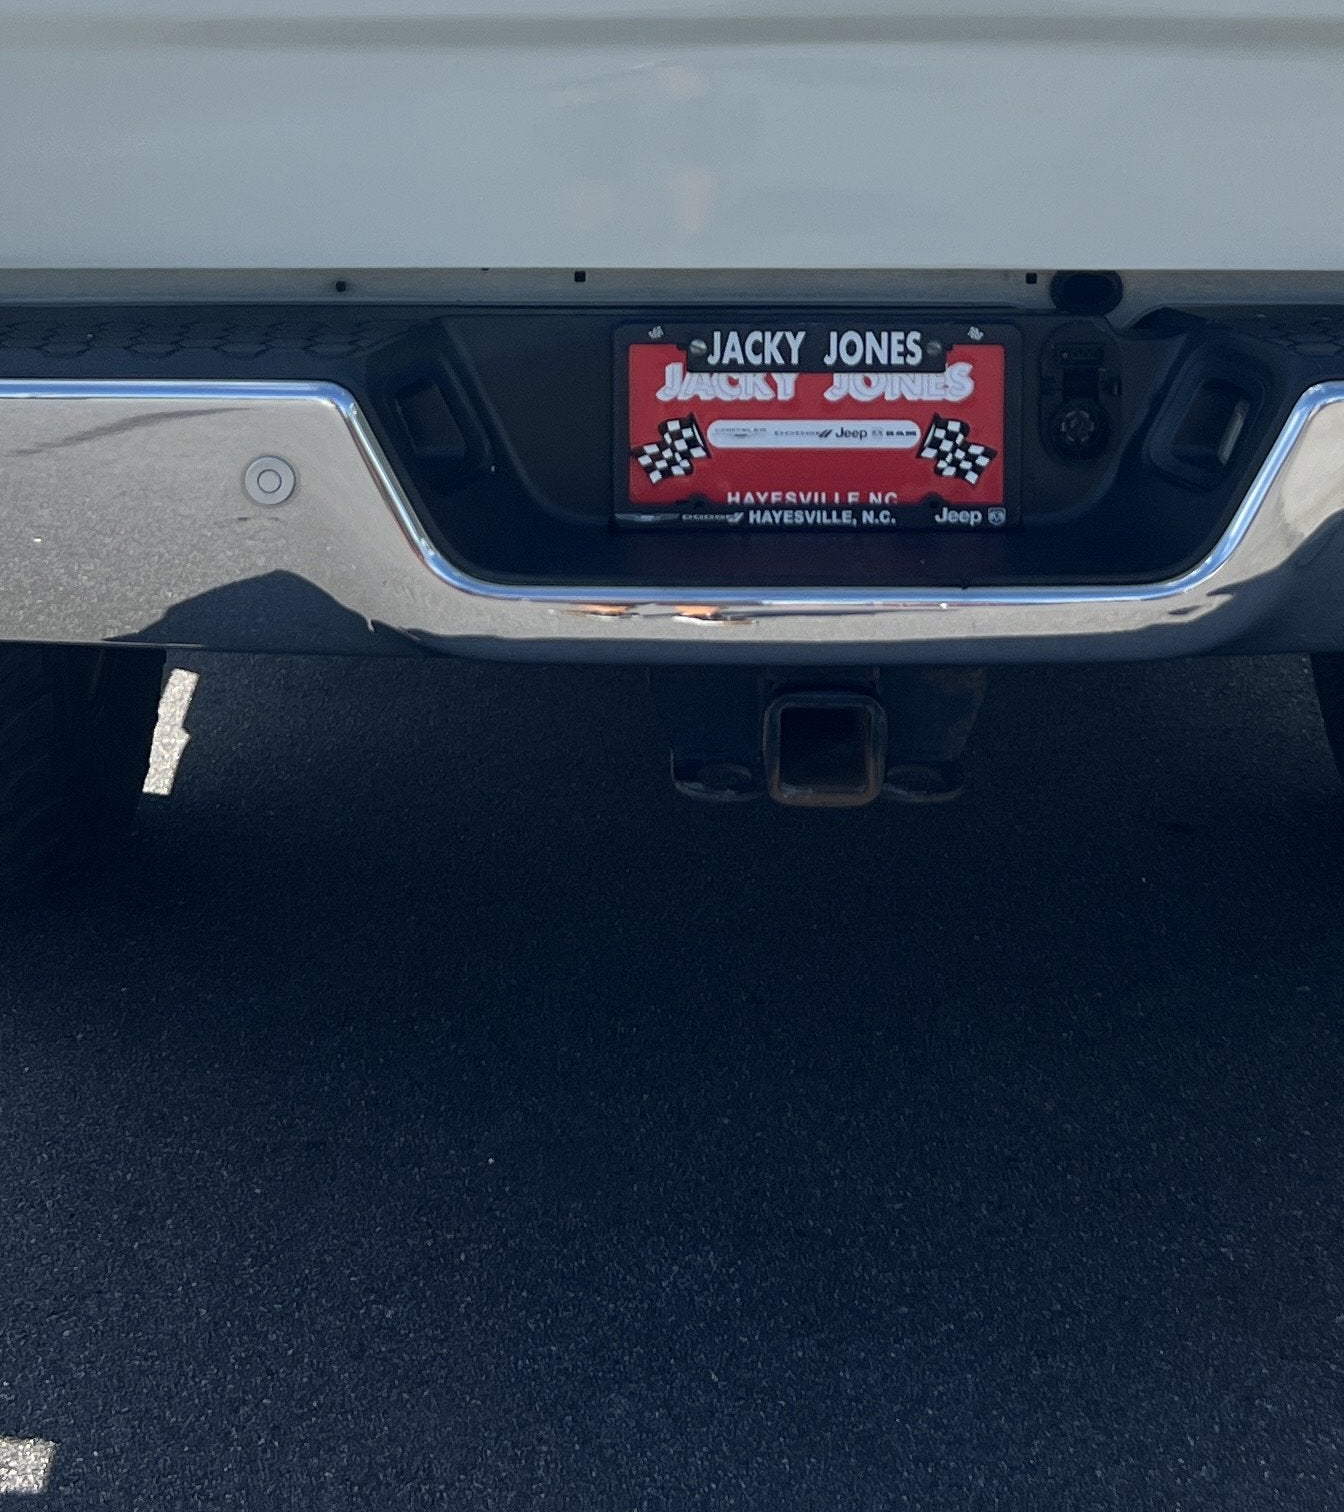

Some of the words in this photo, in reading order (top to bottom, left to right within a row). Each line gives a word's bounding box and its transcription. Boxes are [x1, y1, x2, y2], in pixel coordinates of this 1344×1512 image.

[707, 330, 806, 366] JACKY
[823, 330, 923, 366] JONES
[656, 362, 798, 402] JACKY
[823, 362, 975, 402] JONES
[835, 426, 868, 440] Jeep
[748, 510, 857, 525] HAYESVILLE,
[861, 509, 896, 524] N.C.
[934, 506, 983, 526] Jeep
